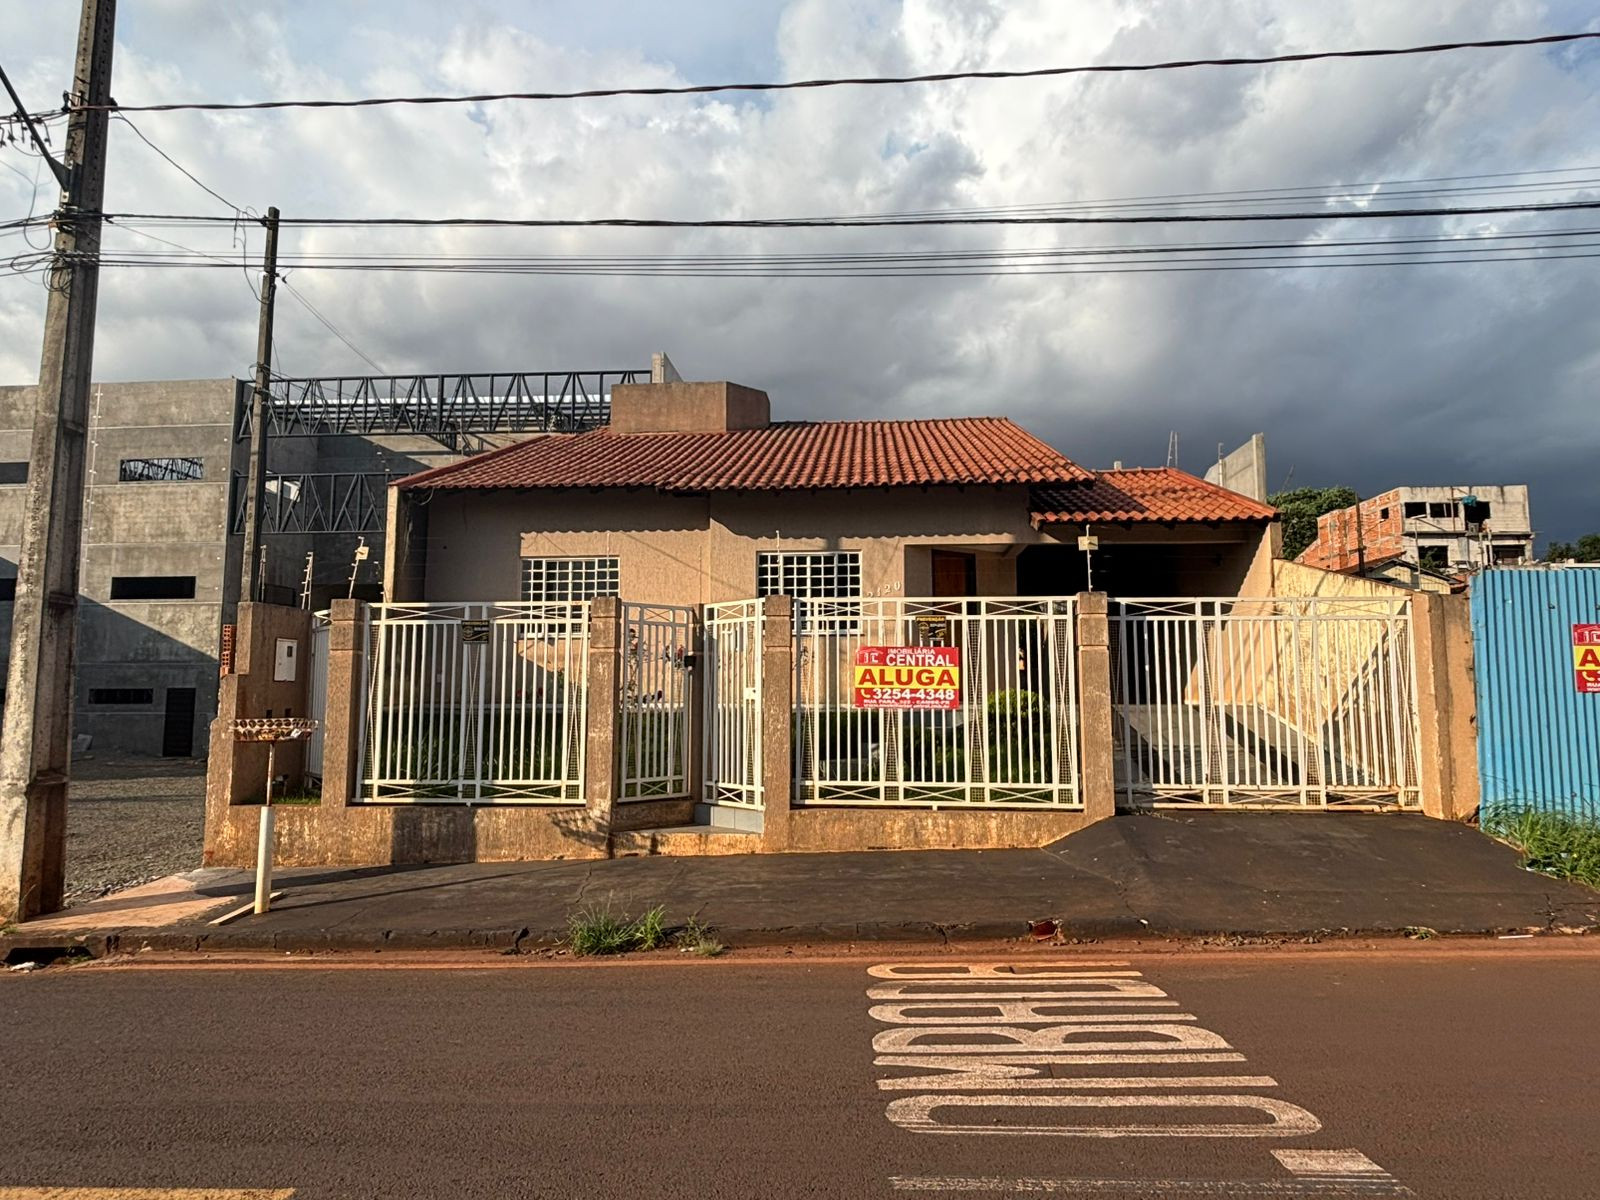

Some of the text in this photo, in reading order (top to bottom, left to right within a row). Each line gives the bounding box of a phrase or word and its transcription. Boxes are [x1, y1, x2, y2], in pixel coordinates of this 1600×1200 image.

[888, 647, 936, 655] IMOBILIÁRIA
[886, 654, 954, 666] CENTRAL
[858, 668, 956, 686] ALUGA
[873, 688, 955, 700] 3254-4348
